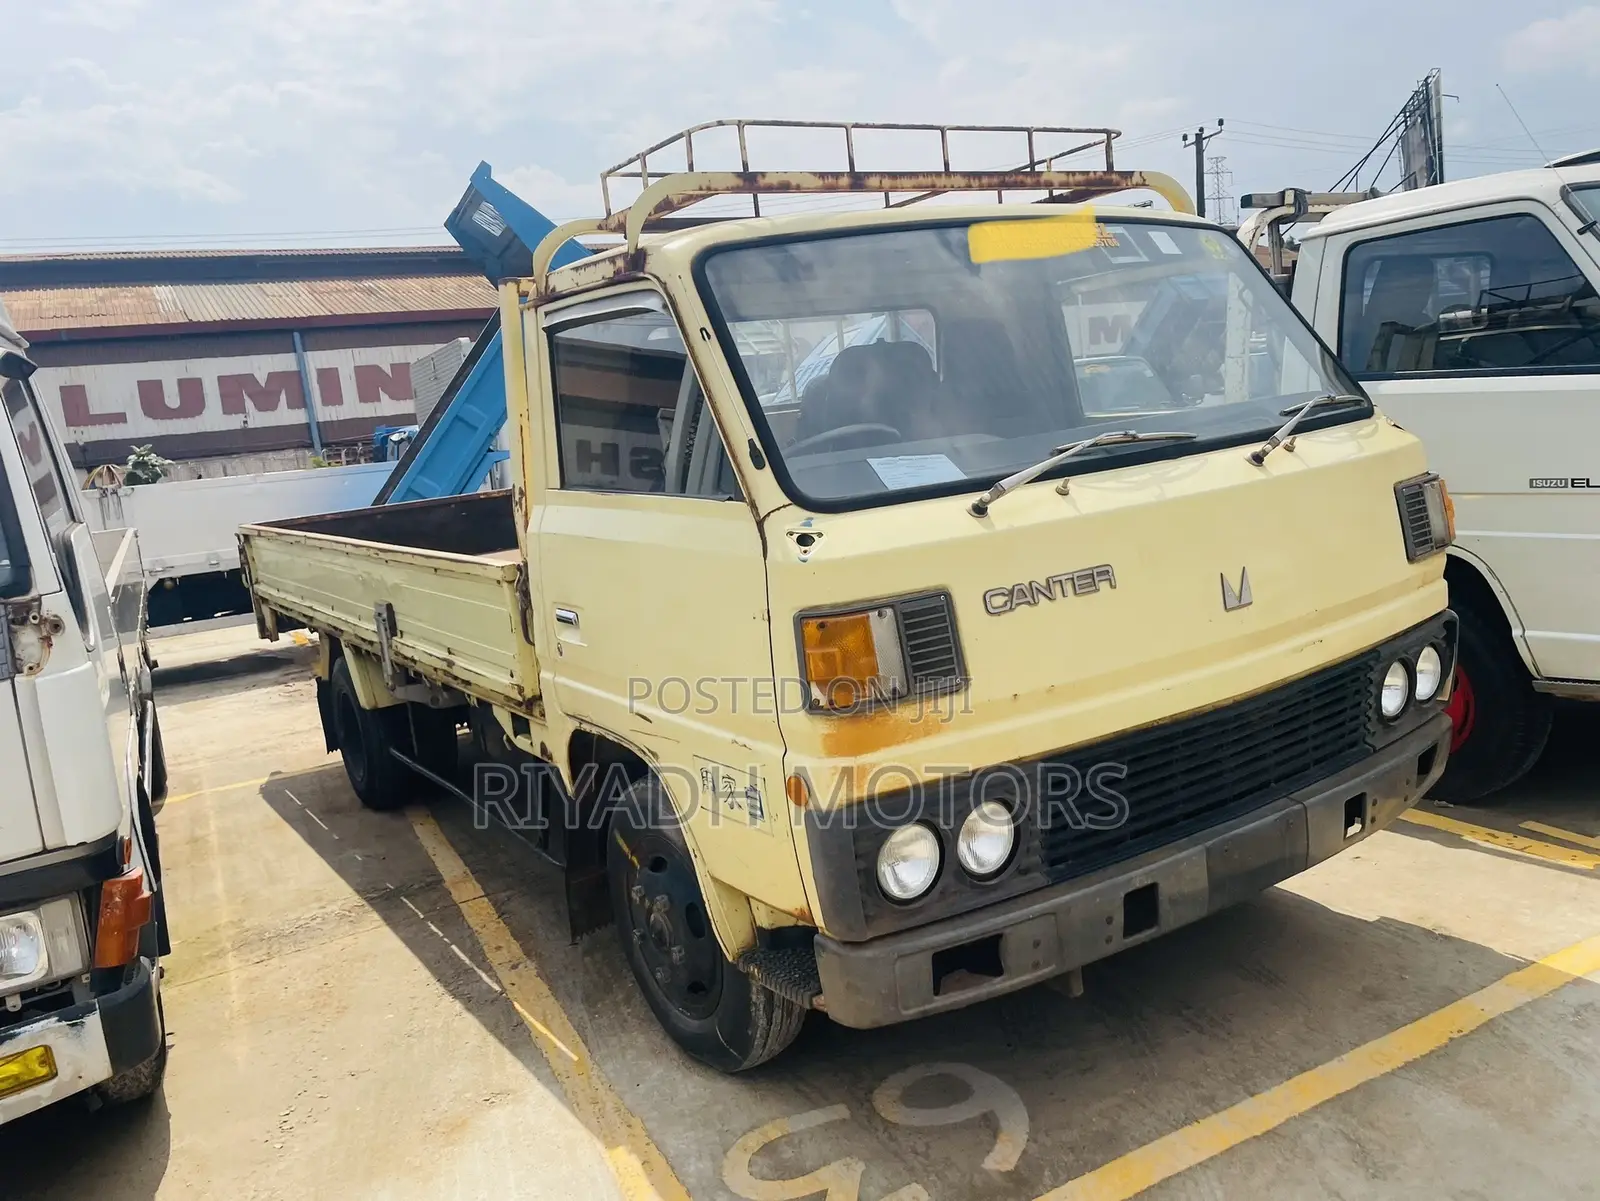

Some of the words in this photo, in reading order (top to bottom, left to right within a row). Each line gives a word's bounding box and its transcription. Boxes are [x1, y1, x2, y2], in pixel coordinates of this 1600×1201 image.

[59, 362, 415, 428] LUMIN
[1531, 479, 1567, 488] ISUZU
[1571, 478, 1600, 489] EL
[983, 564, 1117, 616] CANTER
